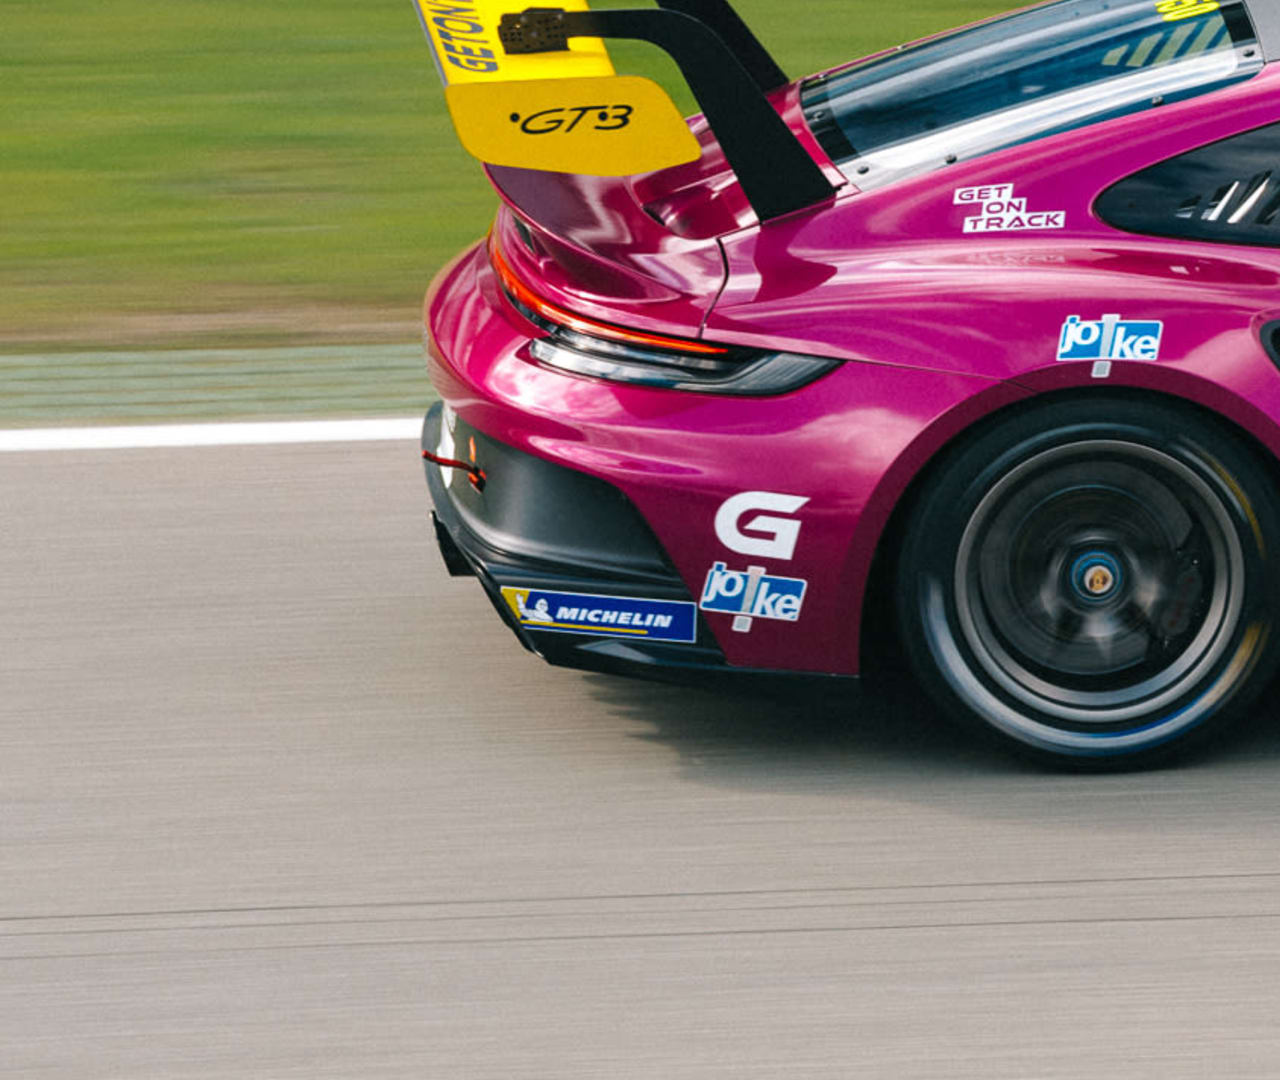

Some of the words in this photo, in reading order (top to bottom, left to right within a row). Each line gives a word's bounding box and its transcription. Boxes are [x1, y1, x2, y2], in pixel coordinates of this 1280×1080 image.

[521, 104, 634, 135] GT3
[958, 186, 1009, 201] GET
[986, 200, 1022, 214] ON
[969, 214, 1061, 230] TRACK
[714, 491, 811, 560] G
[556, 606, 673, 628] MICHELIN
